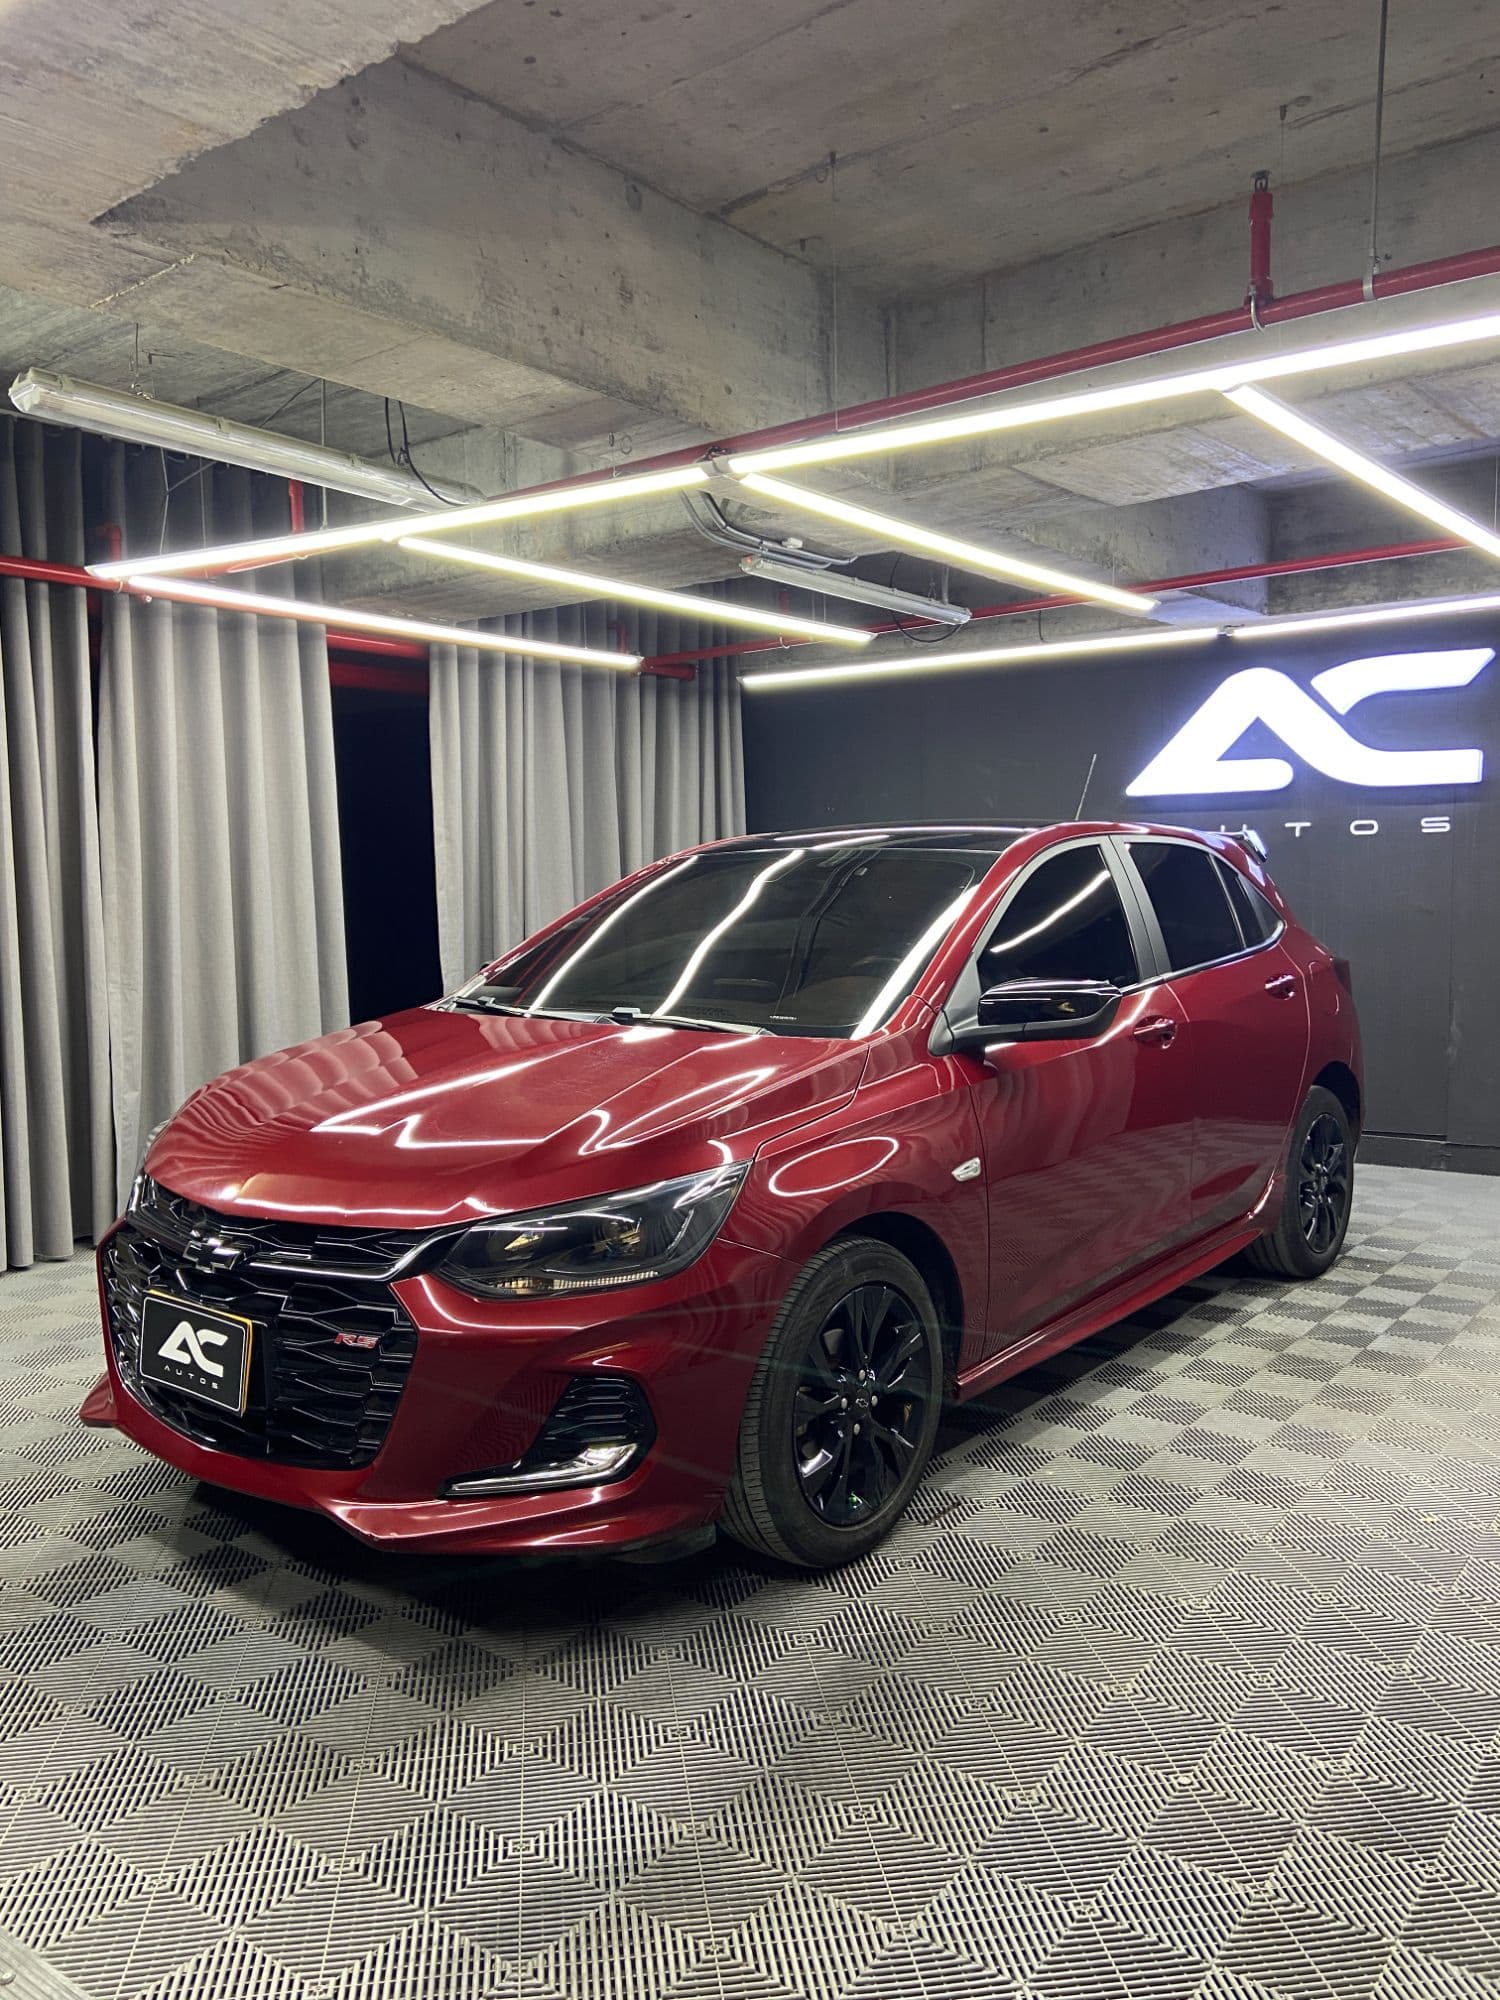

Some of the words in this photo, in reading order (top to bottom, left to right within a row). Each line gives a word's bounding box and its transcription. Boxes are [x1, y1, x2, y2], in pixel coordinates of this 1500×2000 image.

[1126, 648, 1496, 797] AC
[158, 1321, 229, 1378] AC
[335, 1332, 379, 1349] RS
[164, 1365, 218, 1390] AUTOS
